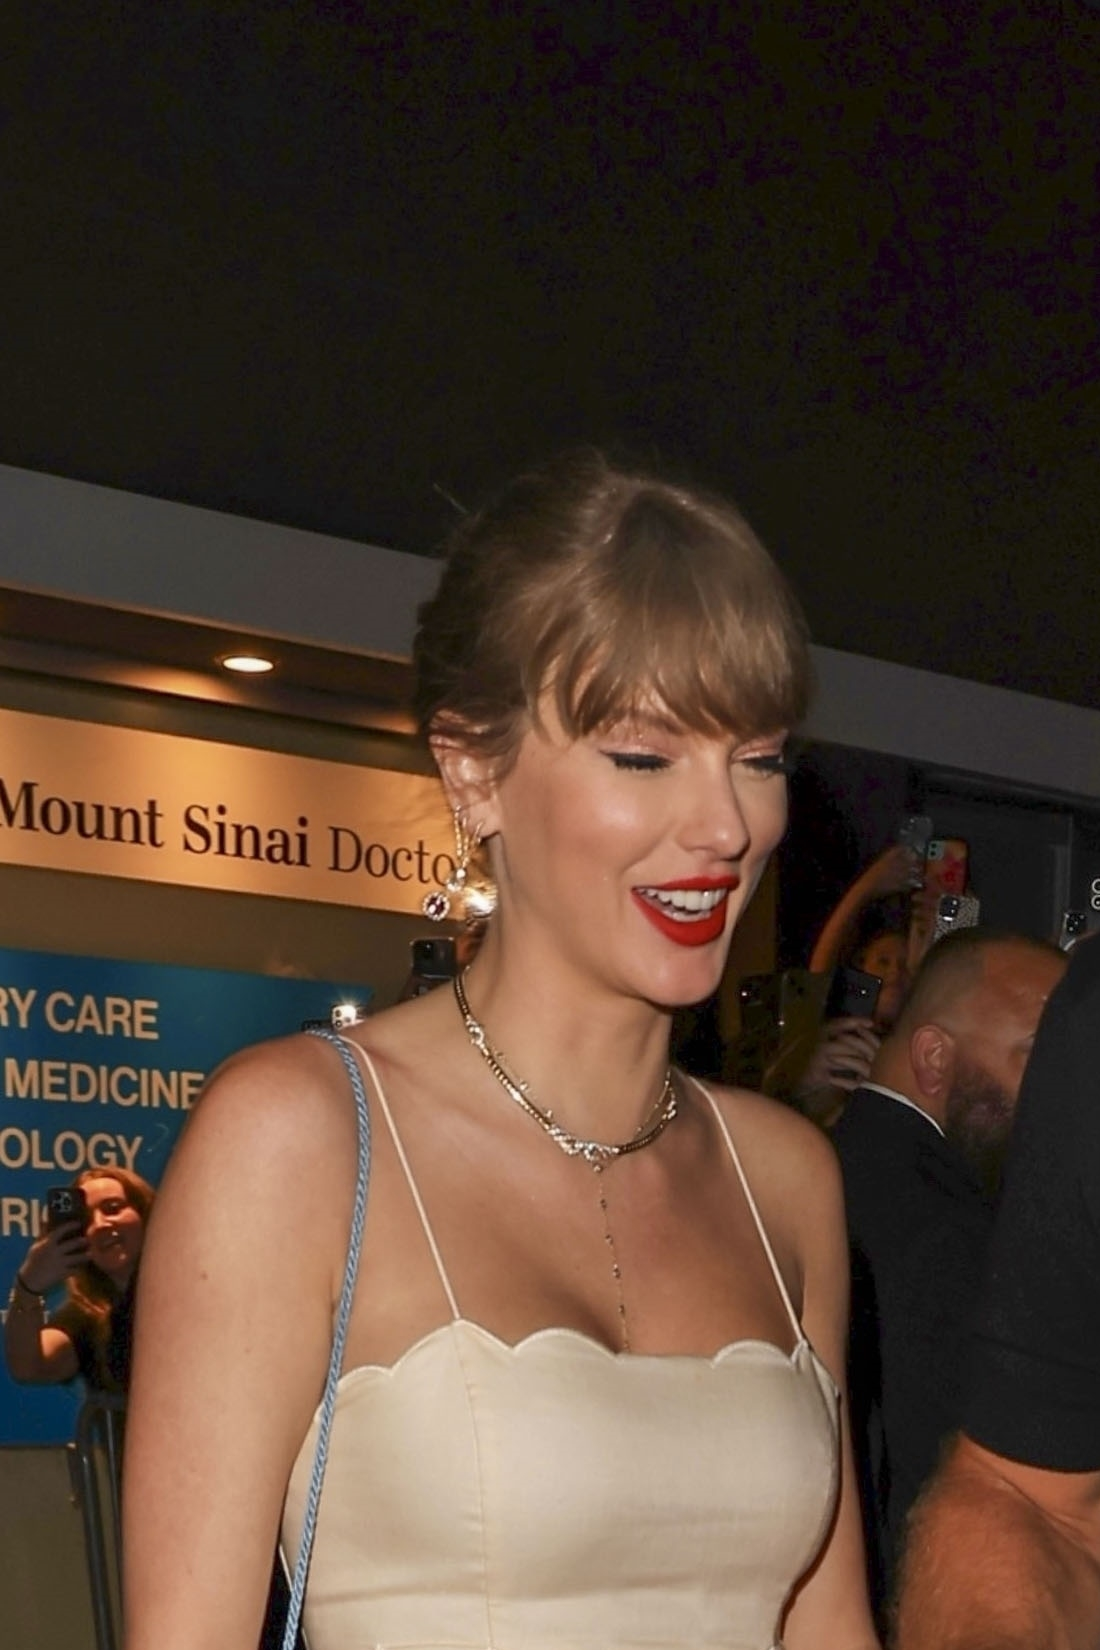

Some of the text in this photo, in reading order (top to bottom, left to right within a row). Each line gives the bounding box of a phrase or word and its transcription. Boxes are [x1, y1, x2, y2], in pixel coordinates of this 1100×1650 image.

[0, 777, 455, 886] Mount Sinai Docto
[45, 991, 159, 1040] CARE
[5, 1058, 205, 1110] MEDICINE
[0, 1127, 143, 1172] OLOGY
[2, 1197, 49, 1238] RI
